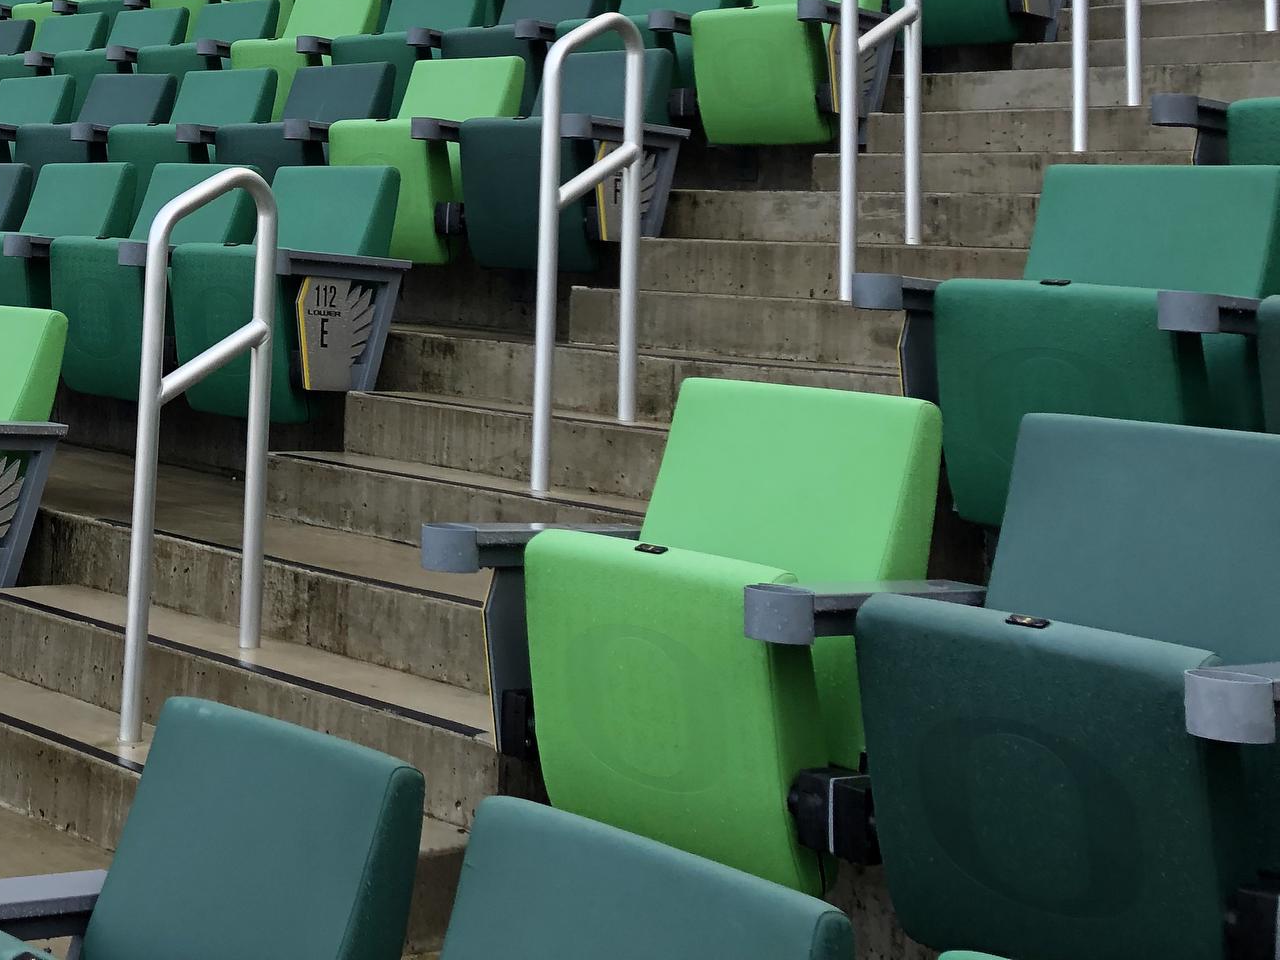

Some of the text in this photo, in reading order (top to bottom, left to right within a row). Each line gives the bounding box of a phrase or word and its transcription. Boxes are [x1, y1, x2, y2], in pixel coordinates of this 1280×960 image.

[315, 285, 337, 308] 112
[307, 309, 341, 317] LOWER
[320, 318, 329, 348] E
